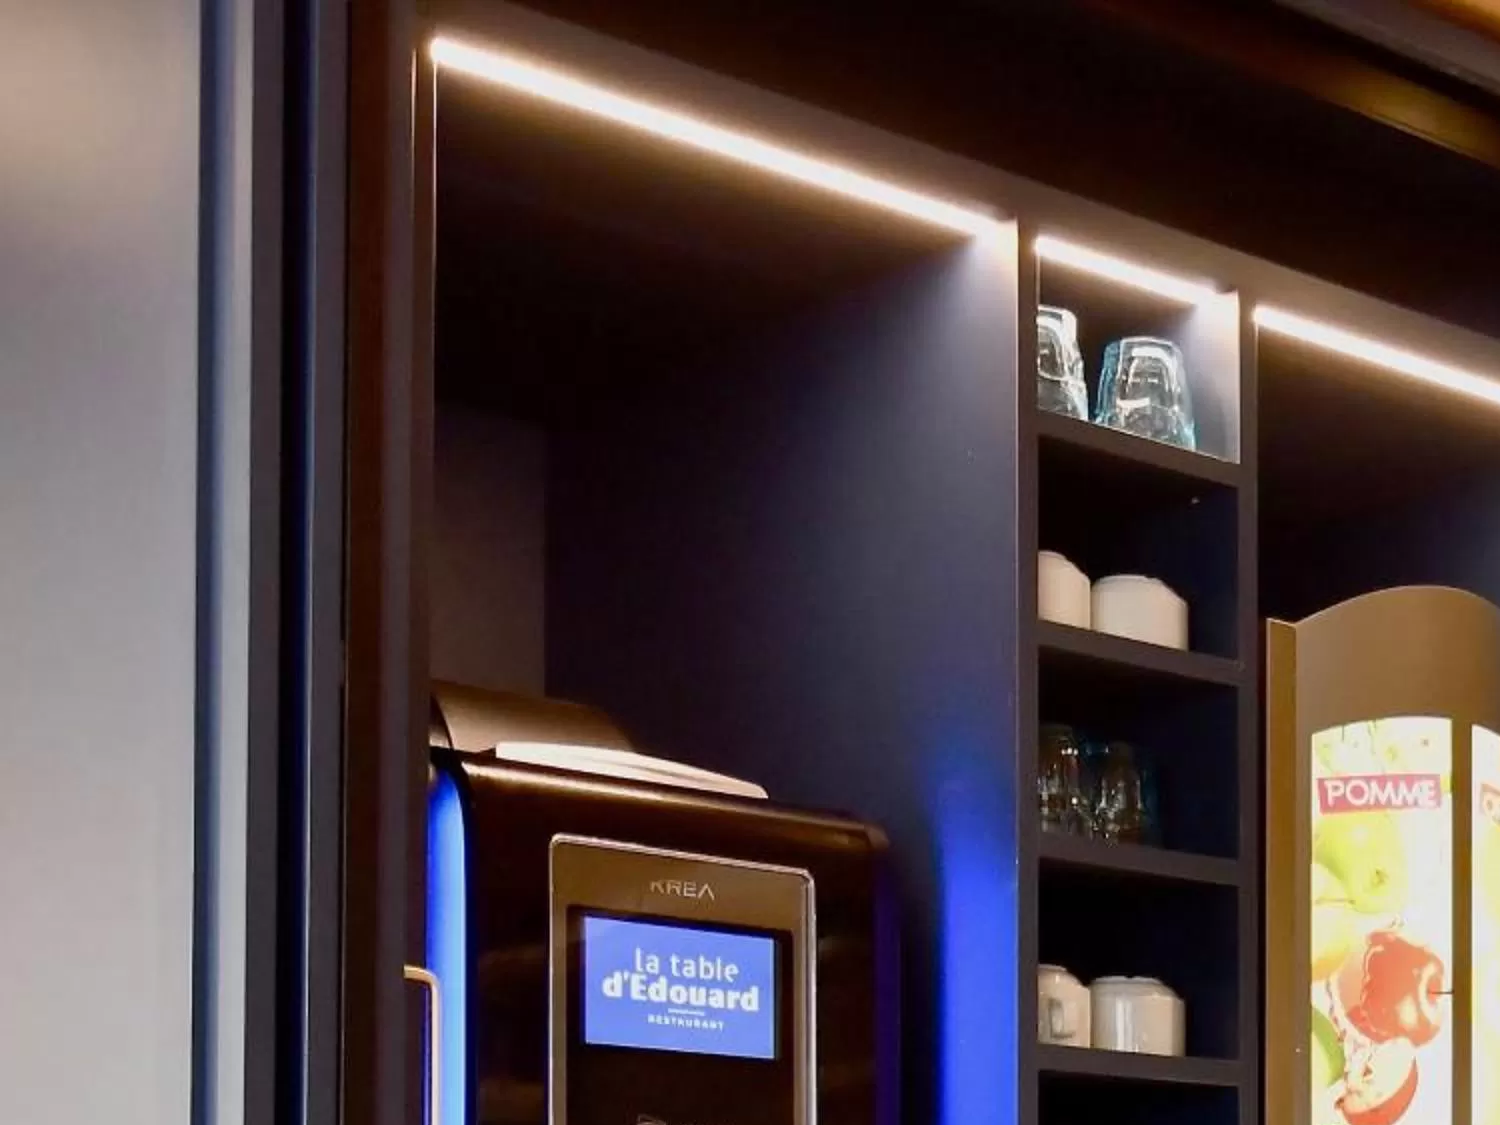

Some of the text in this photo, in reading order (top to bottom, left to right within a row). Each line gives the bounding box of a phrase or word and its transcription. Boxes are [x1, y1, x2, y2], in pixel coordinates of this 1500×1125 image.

[1323, 779, 1436, 808] POMME
[650, 879, 716, 901] KREA
[635, 947, 740, 983] la table
